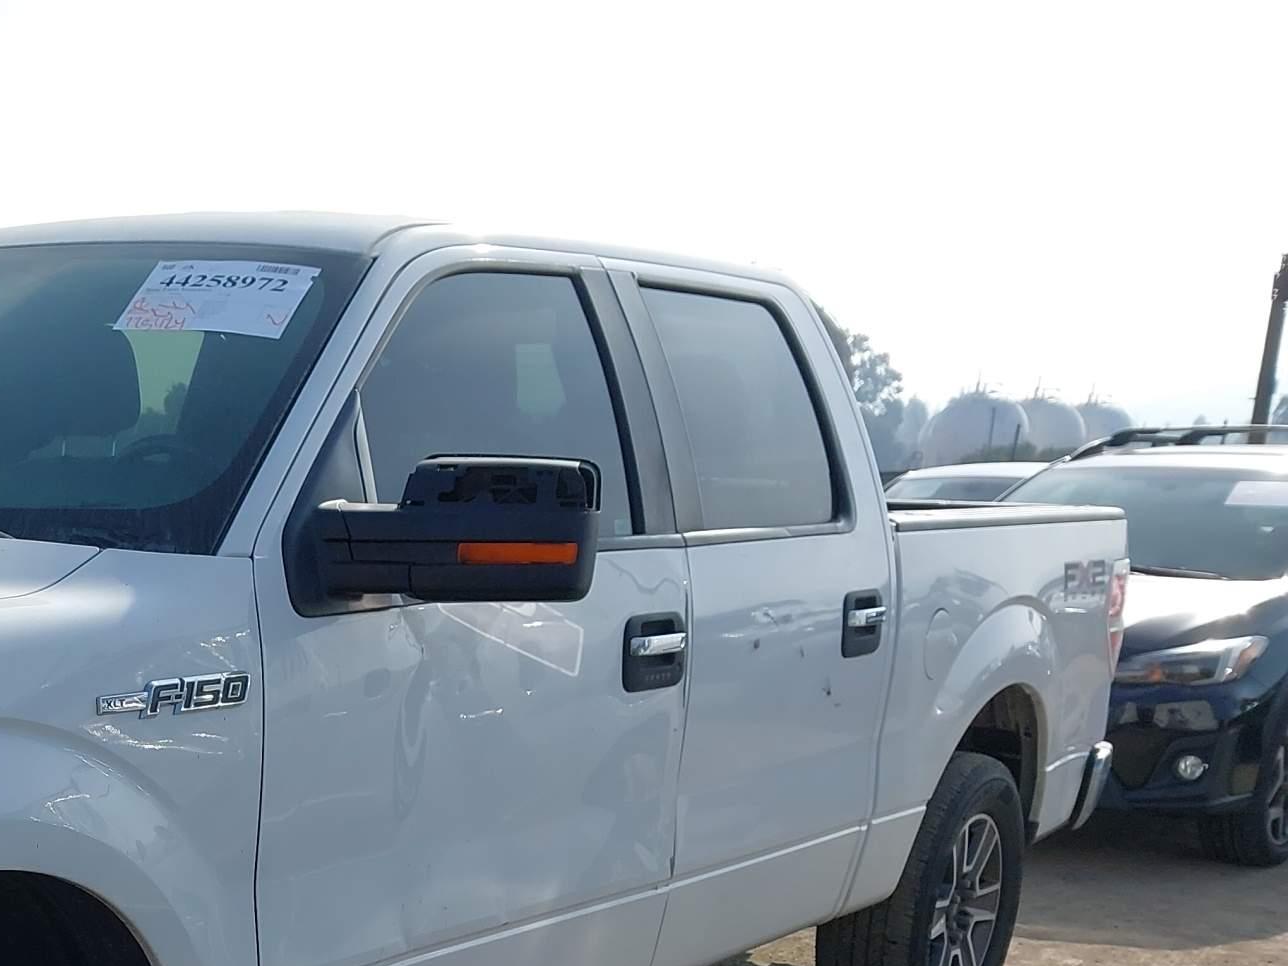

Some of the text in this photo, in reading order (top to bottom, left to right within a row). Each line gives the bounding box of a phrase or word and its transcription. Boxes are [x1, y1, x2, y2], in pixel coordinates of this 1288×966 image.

[160, 274, 288, 292] 44258972
[106, 673, 250, 716] XLT F-150
